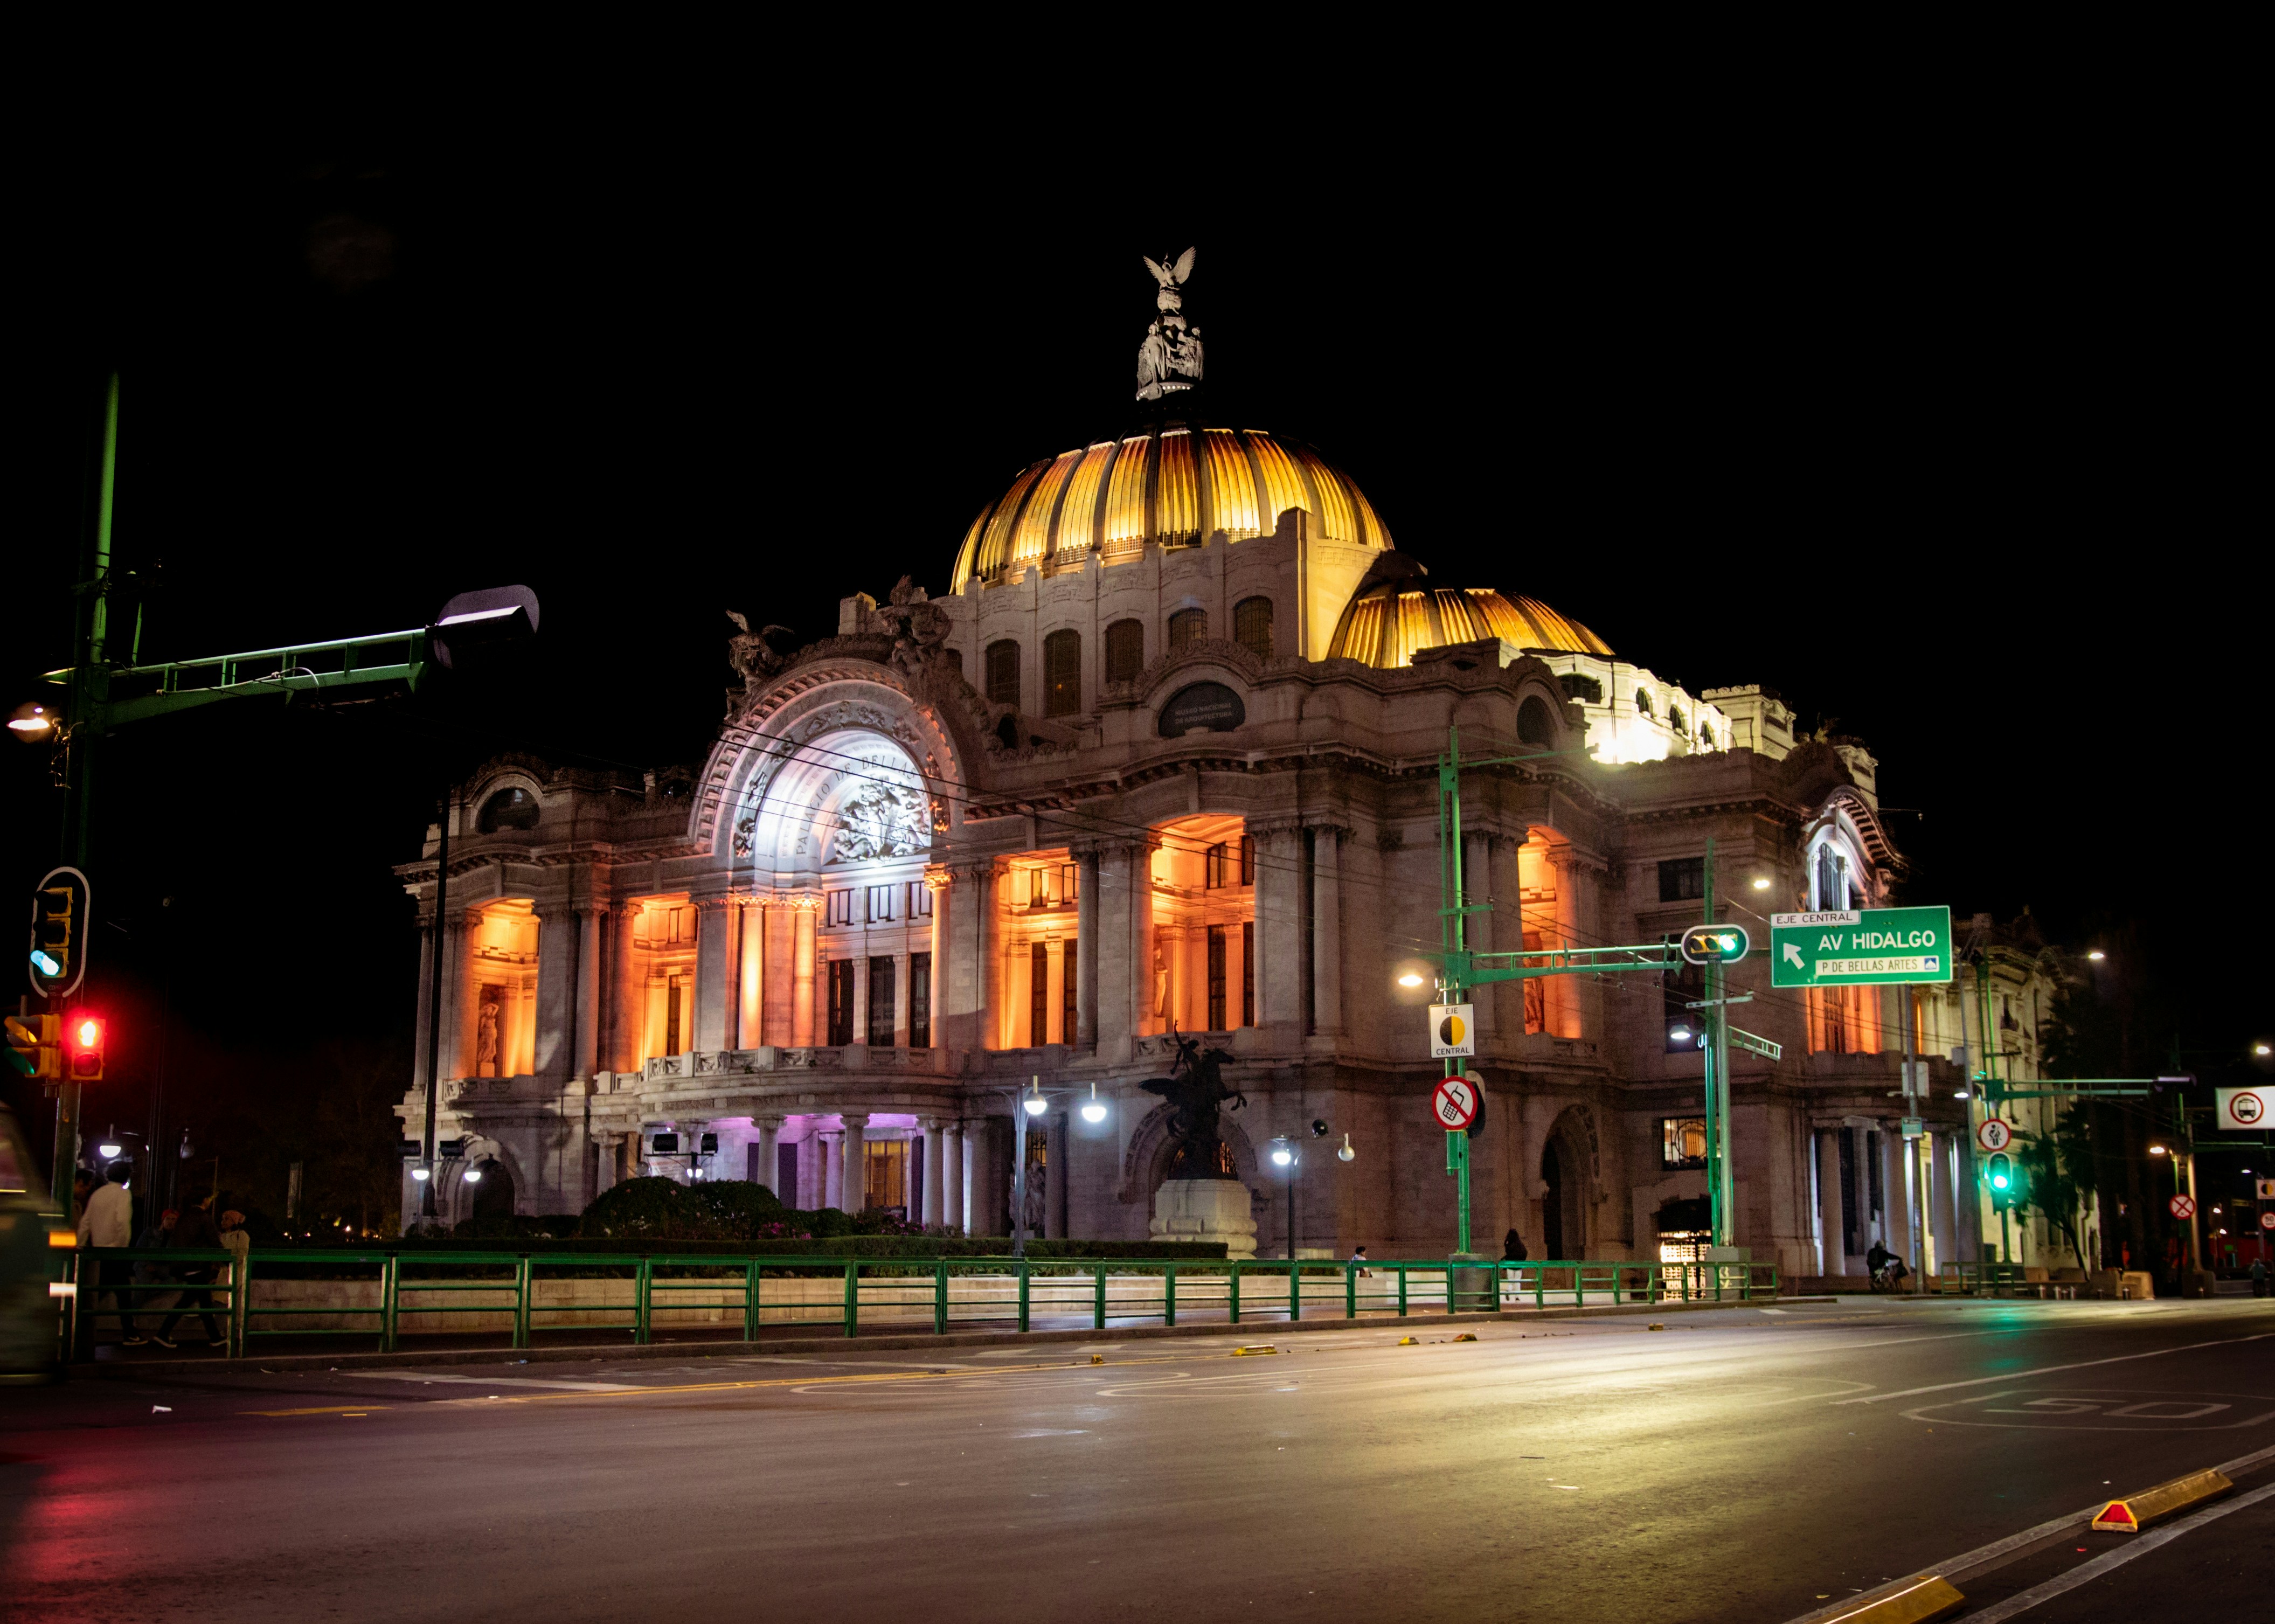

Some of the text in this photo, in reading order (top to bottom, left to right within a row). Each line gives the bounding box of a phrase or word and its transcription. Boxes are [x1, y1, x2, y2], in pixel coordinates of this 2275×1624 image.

[796, 783, 830, 855] PALACIO
[835, 762, 854, 781] DE
[1777, 913, 1853, 924] EJE CENTRAL
[1818, 930, 1936, 951] AV HIDALGO
[1822, 959, 1917, 973] P DE BELLAS ARTES
[1436, 1047, 1469, 1055] CENTRAL
[1982, 1398, 2232, 1419] 50
